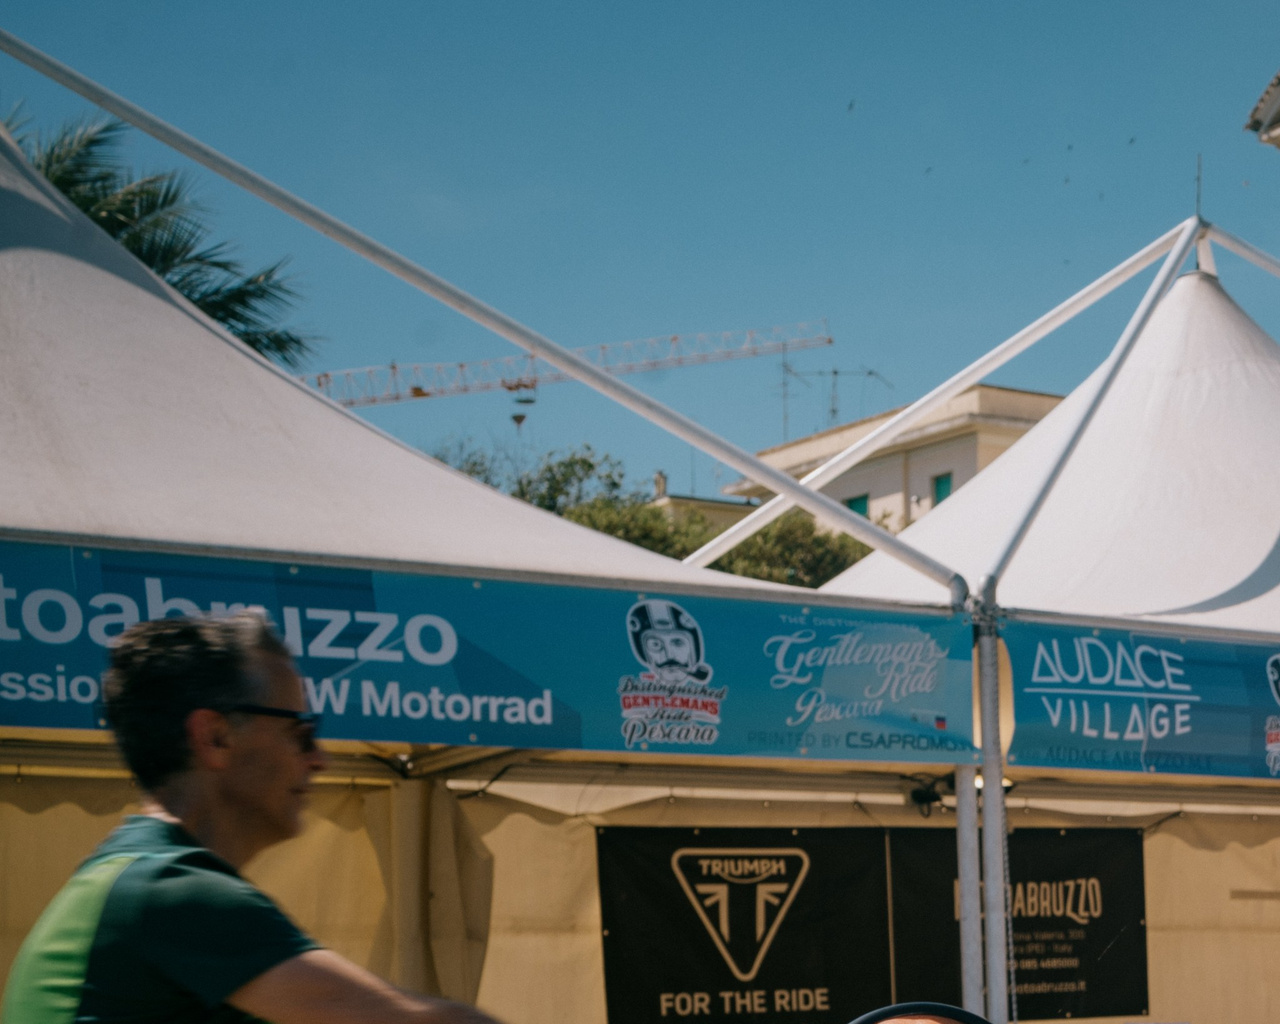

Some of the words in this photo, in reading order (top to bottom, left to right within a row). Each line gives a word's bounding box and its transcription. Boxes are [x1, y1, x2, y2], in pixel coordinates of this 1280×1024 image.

[0, 573, 458, 666] toabzzo
[762, 629, 950, 689] Gentleman's
[864, 659, 939, 703] Ride
[1032, 636, 1191, 691] AUDACE
[0, 665, 107, 705] ssio
[361, 680, 553, 725] Motorrad
[621, 694, 719, 716] GENTLEMANS
[785, 687, 884, 728] Pescara
[1041, 695, 1192, 741] VILLAGE
[621, 717, 718, 748] Pescara
[698, 859, 786, 876] TRIUMPH
[953, 878, 1103, 925] ABRUZZO
[660, 992, 711, 1017] FOR
[719, 989, 767, 1015] THE
[774, 987, 830, 1013] RIDE
